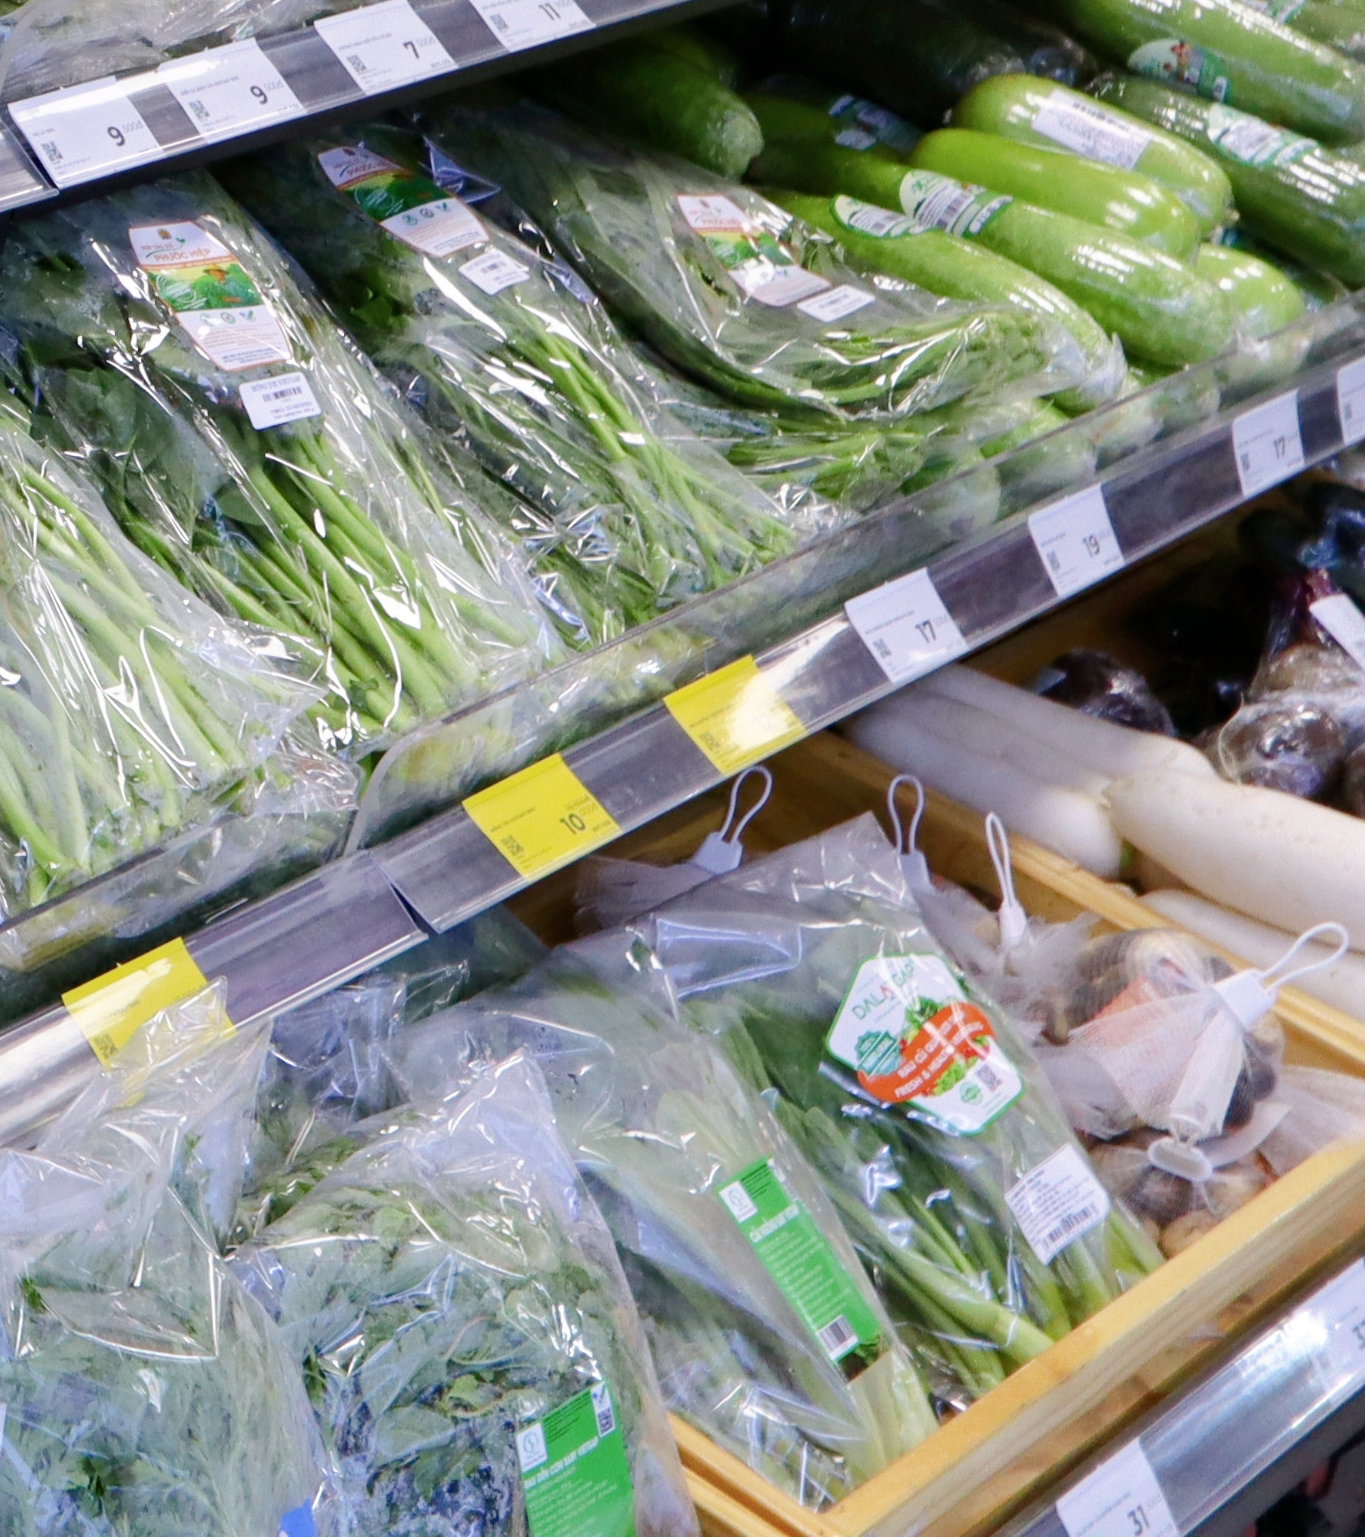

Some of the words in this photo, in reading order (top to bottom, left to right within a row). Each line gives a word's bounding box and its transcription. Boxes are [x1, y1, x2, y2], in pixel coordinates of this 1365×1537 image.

[537, 2, 562, 22] 11
[402, 39, 421, 60] 7
[249, 84, 269, 105] 9
[106, 124, 127, 147] 9
[1081, 534, 1100, 559] 19
[914, 618, 939, 644] 17
[558, 813, 586, 835] 10
[1126, 1503, 1151, 1534] 31
